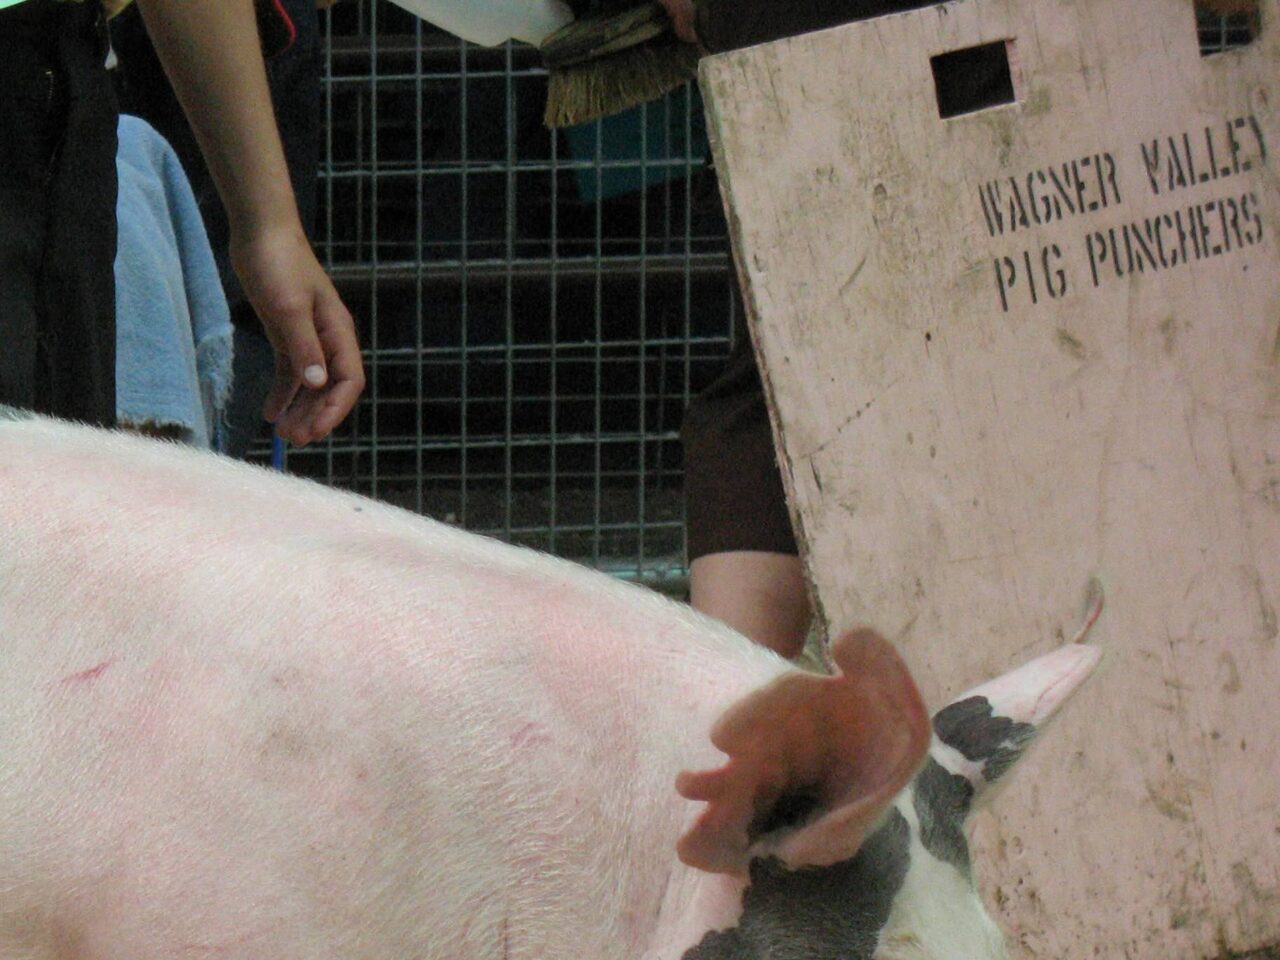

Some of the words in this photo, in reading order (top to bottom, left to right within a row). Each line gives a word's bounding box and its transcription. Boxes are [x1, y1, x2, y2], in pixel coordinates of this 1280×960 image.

[978, 153, 1121, 237] WAGNER
[1140, 115, 1266, 194] VALLEY
[994, 244, 1066, 312] PIG
[1086, 193, 1263, 287] PUNCHERS
